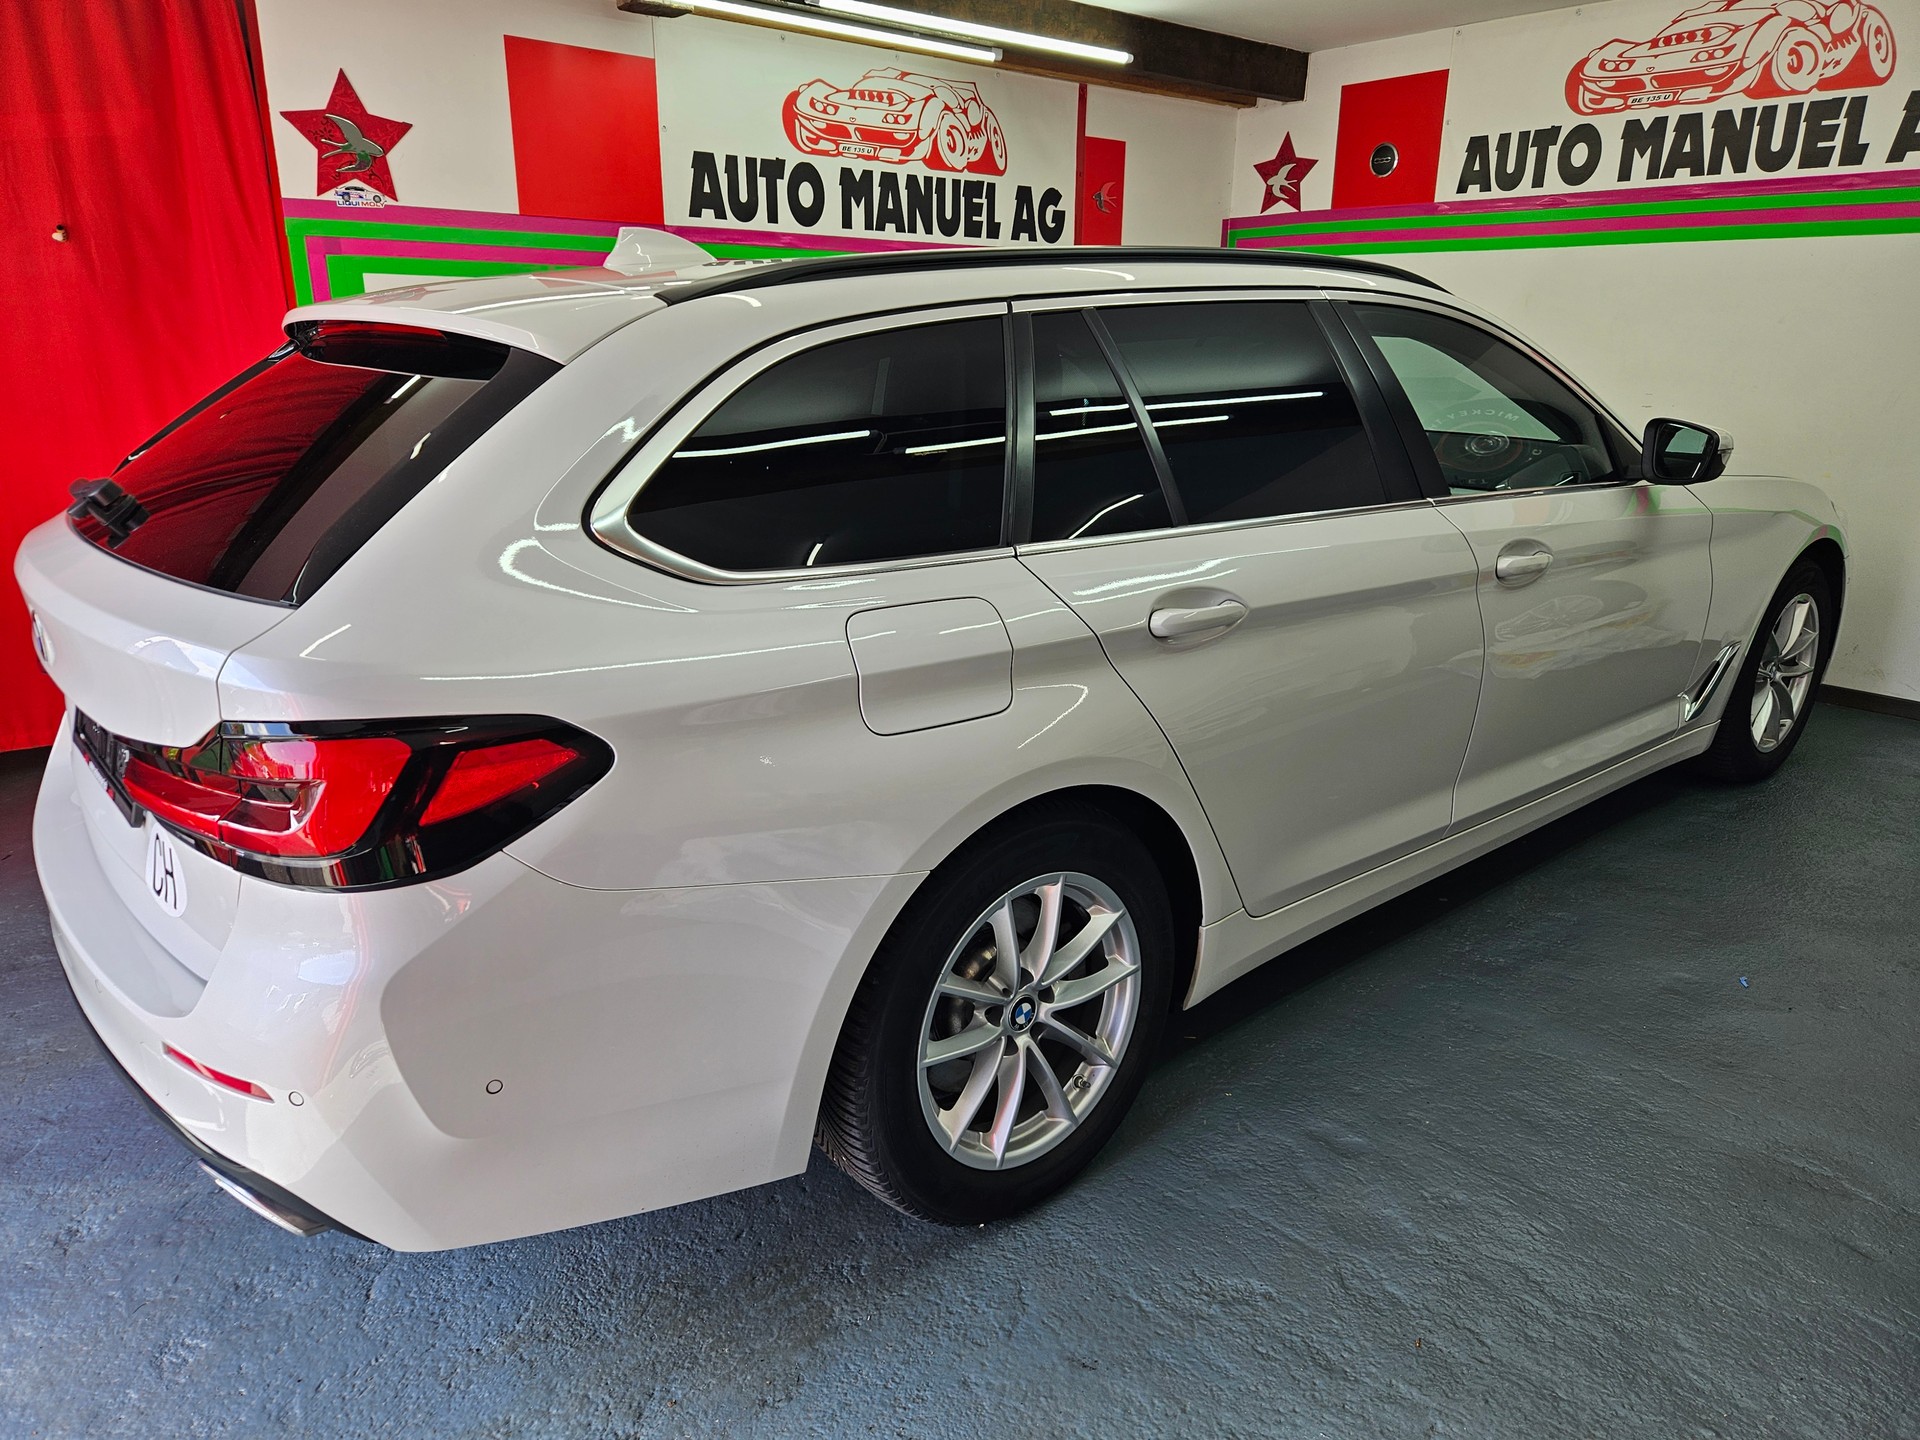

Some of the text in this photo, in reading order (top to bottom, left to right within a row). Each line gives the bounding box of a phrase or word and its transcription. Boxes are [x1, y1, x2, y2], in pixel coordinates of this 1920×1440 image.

[1456, 123, 1602, 194] AUTO
[1617, 95, 1870, 182] MANUEL
[689, 151, 1066, 244] AUTO MANUEL AG
[153, 833, 177, 909] CH
